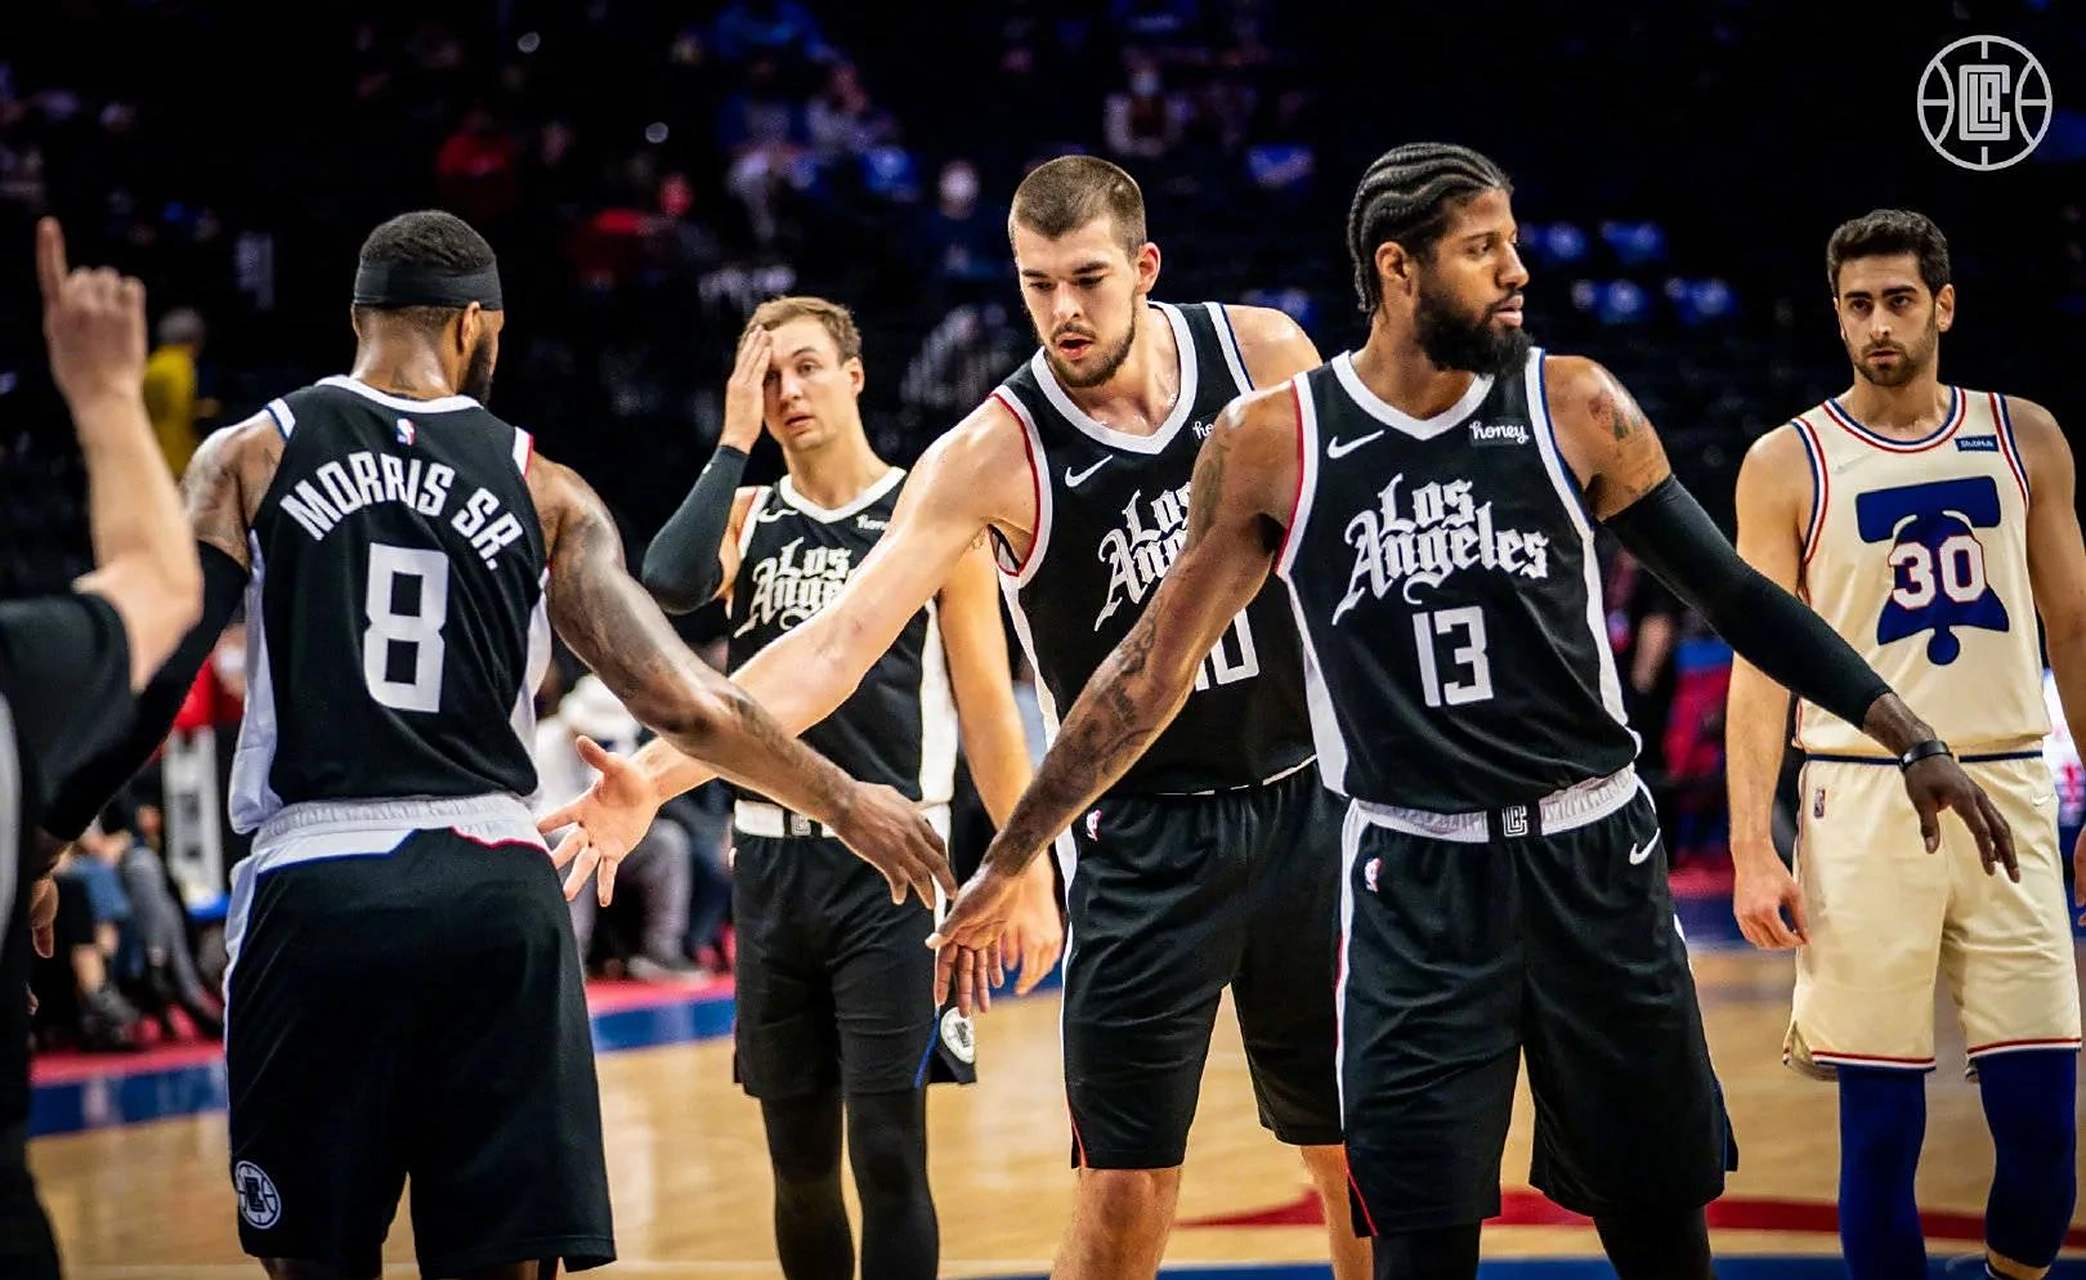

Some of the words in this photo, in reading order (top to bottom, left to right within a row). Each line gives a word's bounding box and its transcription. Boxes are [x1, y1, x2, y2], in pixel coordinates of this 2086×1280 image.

[1469, 421, 1529, 444] honey
[280, 451, 455, 541] MORRIS
[450, 487, 523, 570] SR.
[1378, 473, 1475, 539] Los
[776, 536, 853, 580] Los
[1332, 501, 1548, 626] Angeles
[1888, 535, 1987, 611] 30
[363, 542, 449, 714] 8
[1412, 605, 1494, 708] 13
